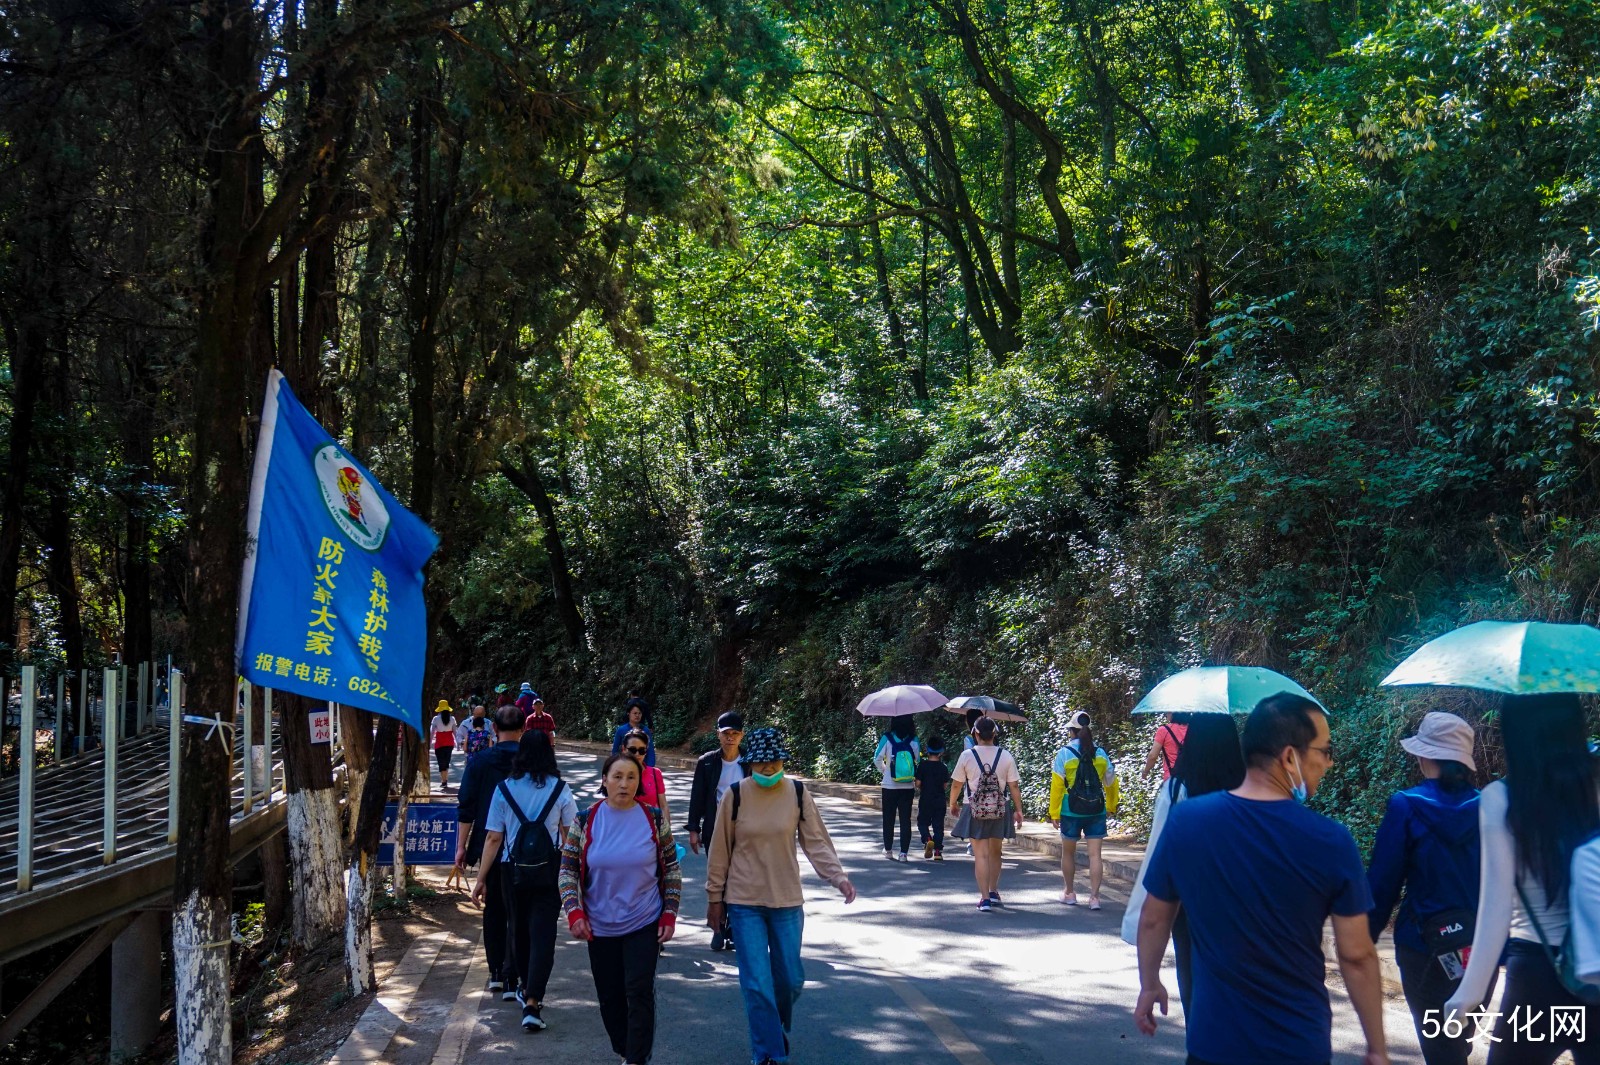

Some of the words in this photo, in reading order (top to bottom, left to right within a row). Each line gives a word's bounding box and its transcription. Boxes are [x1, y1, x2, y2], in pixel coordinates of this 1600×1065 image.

[358, 566, 390, 673] 森林护我
[406, 819, 455, 834] 此处施工
[405, 837, 448, 852] 请绕行!
[1439, 922, 1464, 936] FILA
